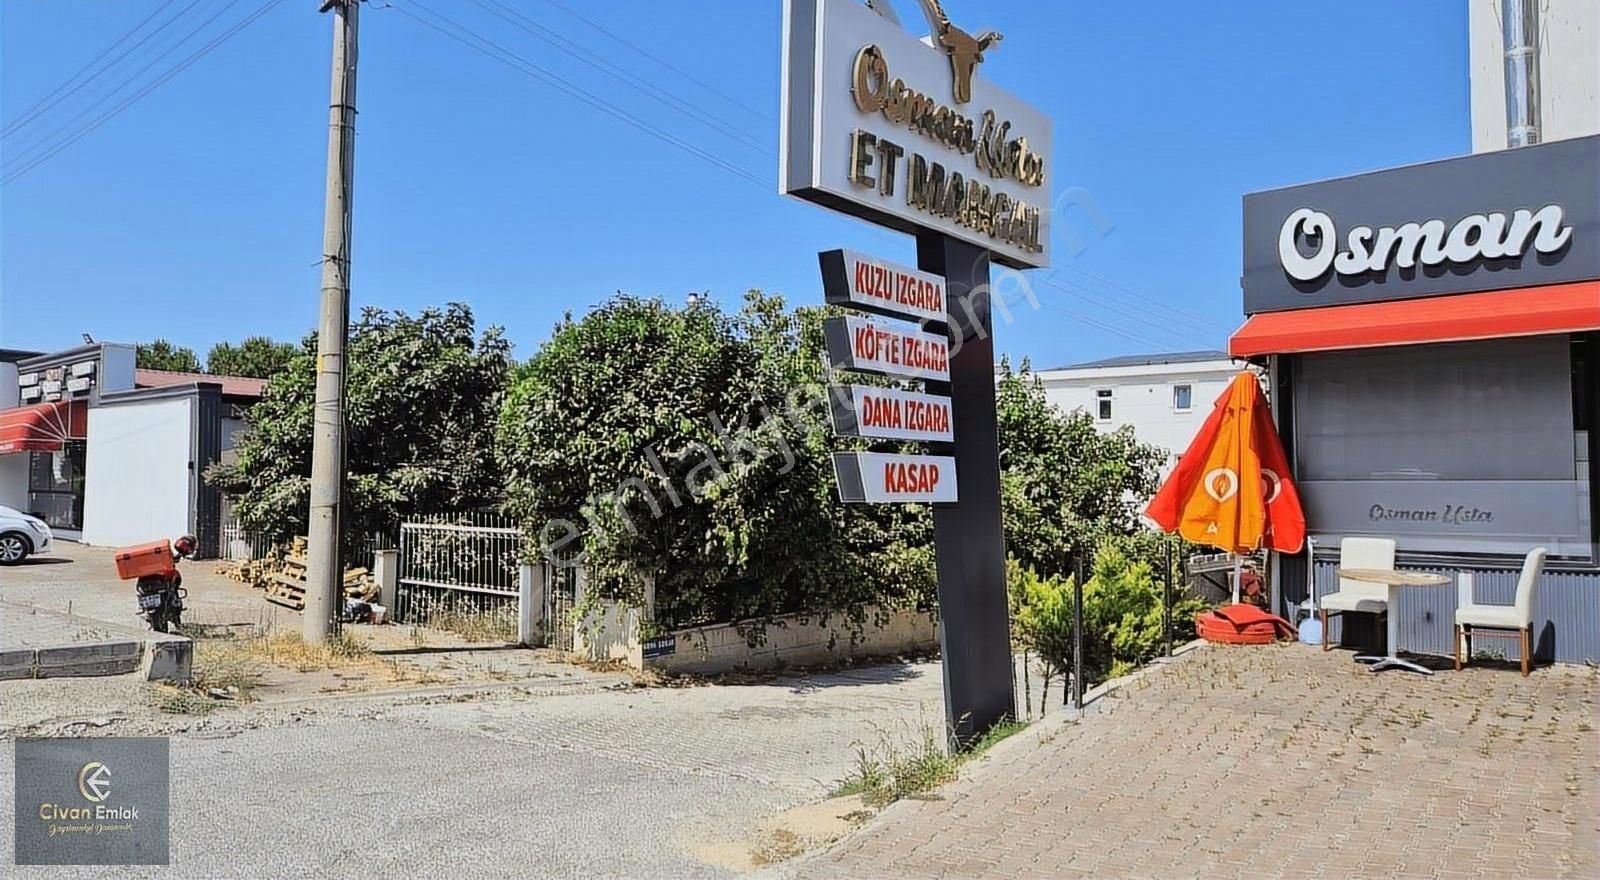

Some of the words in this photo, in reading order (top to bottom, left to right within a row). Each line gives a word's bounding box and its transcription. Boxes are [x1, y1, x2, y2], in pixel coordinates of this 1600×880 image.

[852, 44, 977, 155] Osman
[847, 128, 904, 197] ET
[1278, 202, 1573, 281] Osman
[855, 261, 893, 300] KUZU
[895, 272, 942, 312] IZGARA
[855, 324, 900, 364] KÖFTE
[902, 336, 948, 372] IZGARA
[863, 395, 901, 429] DANA
[904, 400, 950, 433] IZGARA
[885, 463, 939, 493] KASAP
[1369, 504, 1436, 522] Osman
